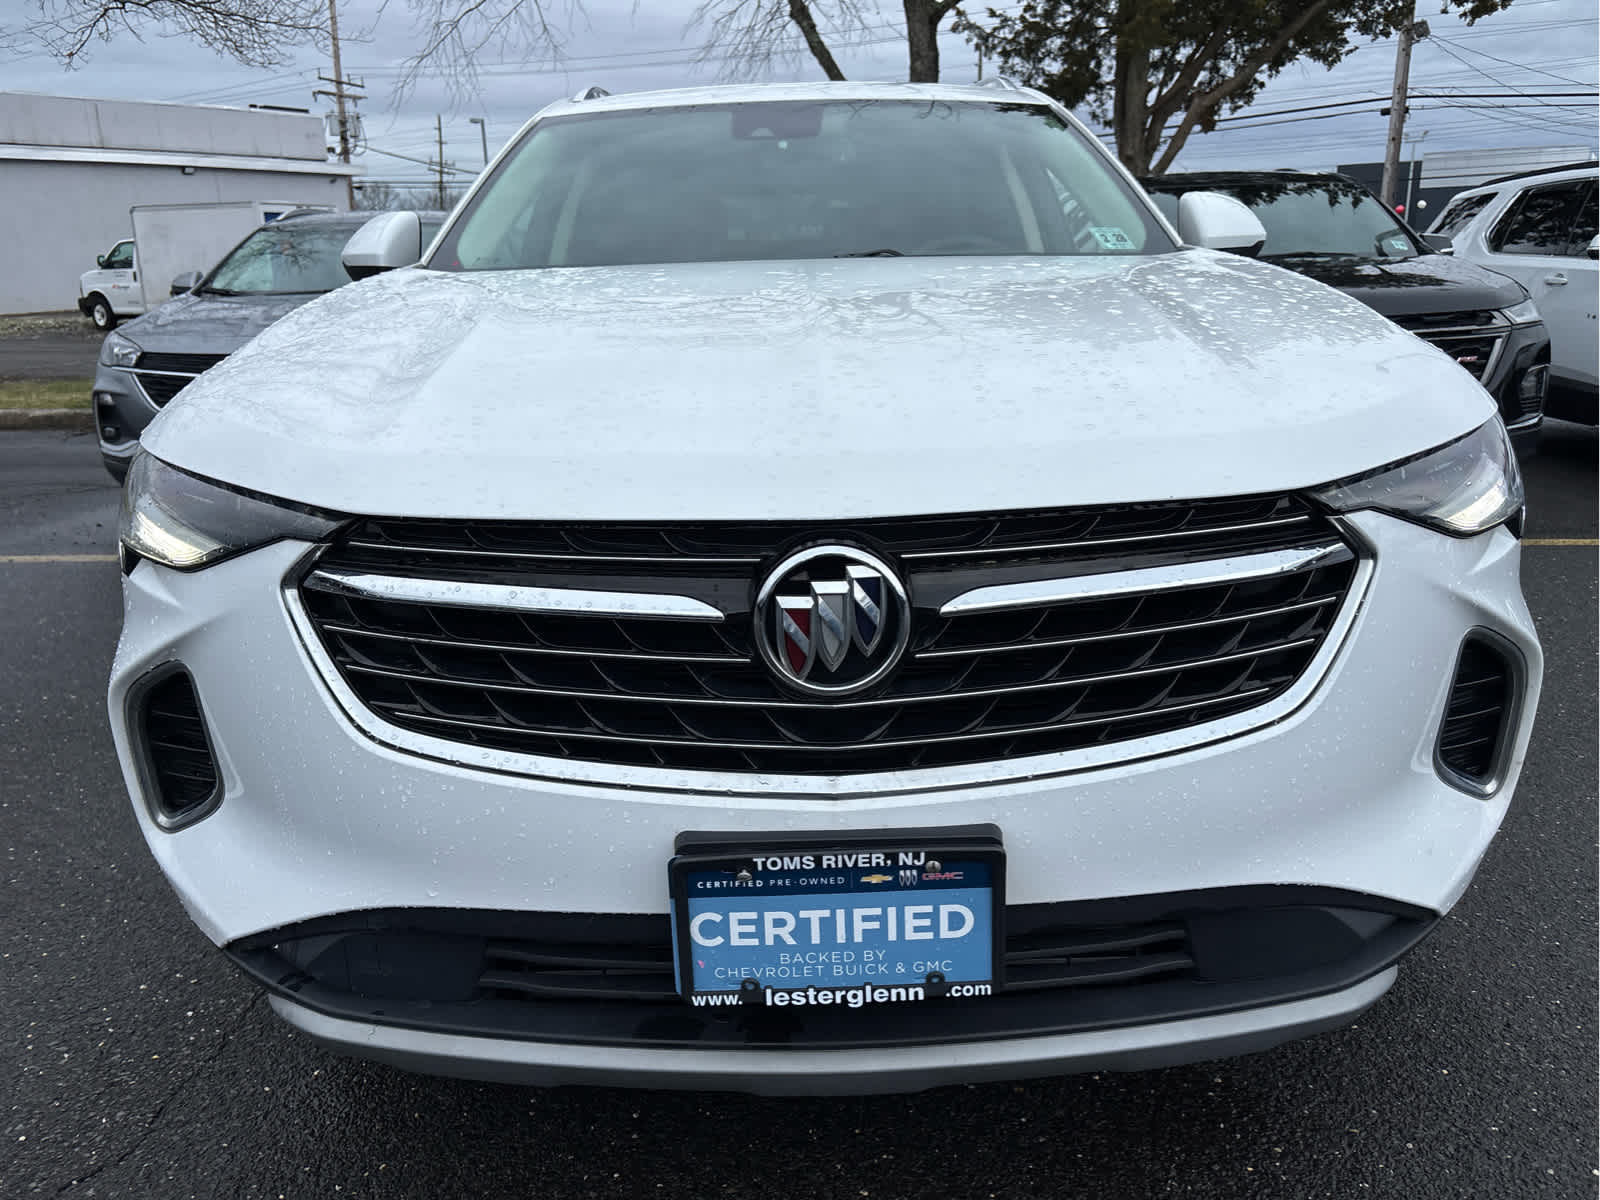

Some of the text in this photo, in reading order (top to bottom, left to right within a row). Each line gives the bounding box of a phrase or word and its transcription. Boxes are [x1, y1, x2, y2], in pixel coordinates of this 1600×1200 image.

[753, 852, 925, 871] TOMS RIVER, NJ
[697, 876, 845, 889] CERTIFIED PRE-OWNED
[922, 871, 964, 881] GMC
[690, 904, 975, 947] CERTIFIED
[780, 950, 886, 964] BACKED BY
[714, 960, 953, 979] CHEVROLET BUICK & GMC
[691, 984, 992, 1008] www. lesterglenn .com
